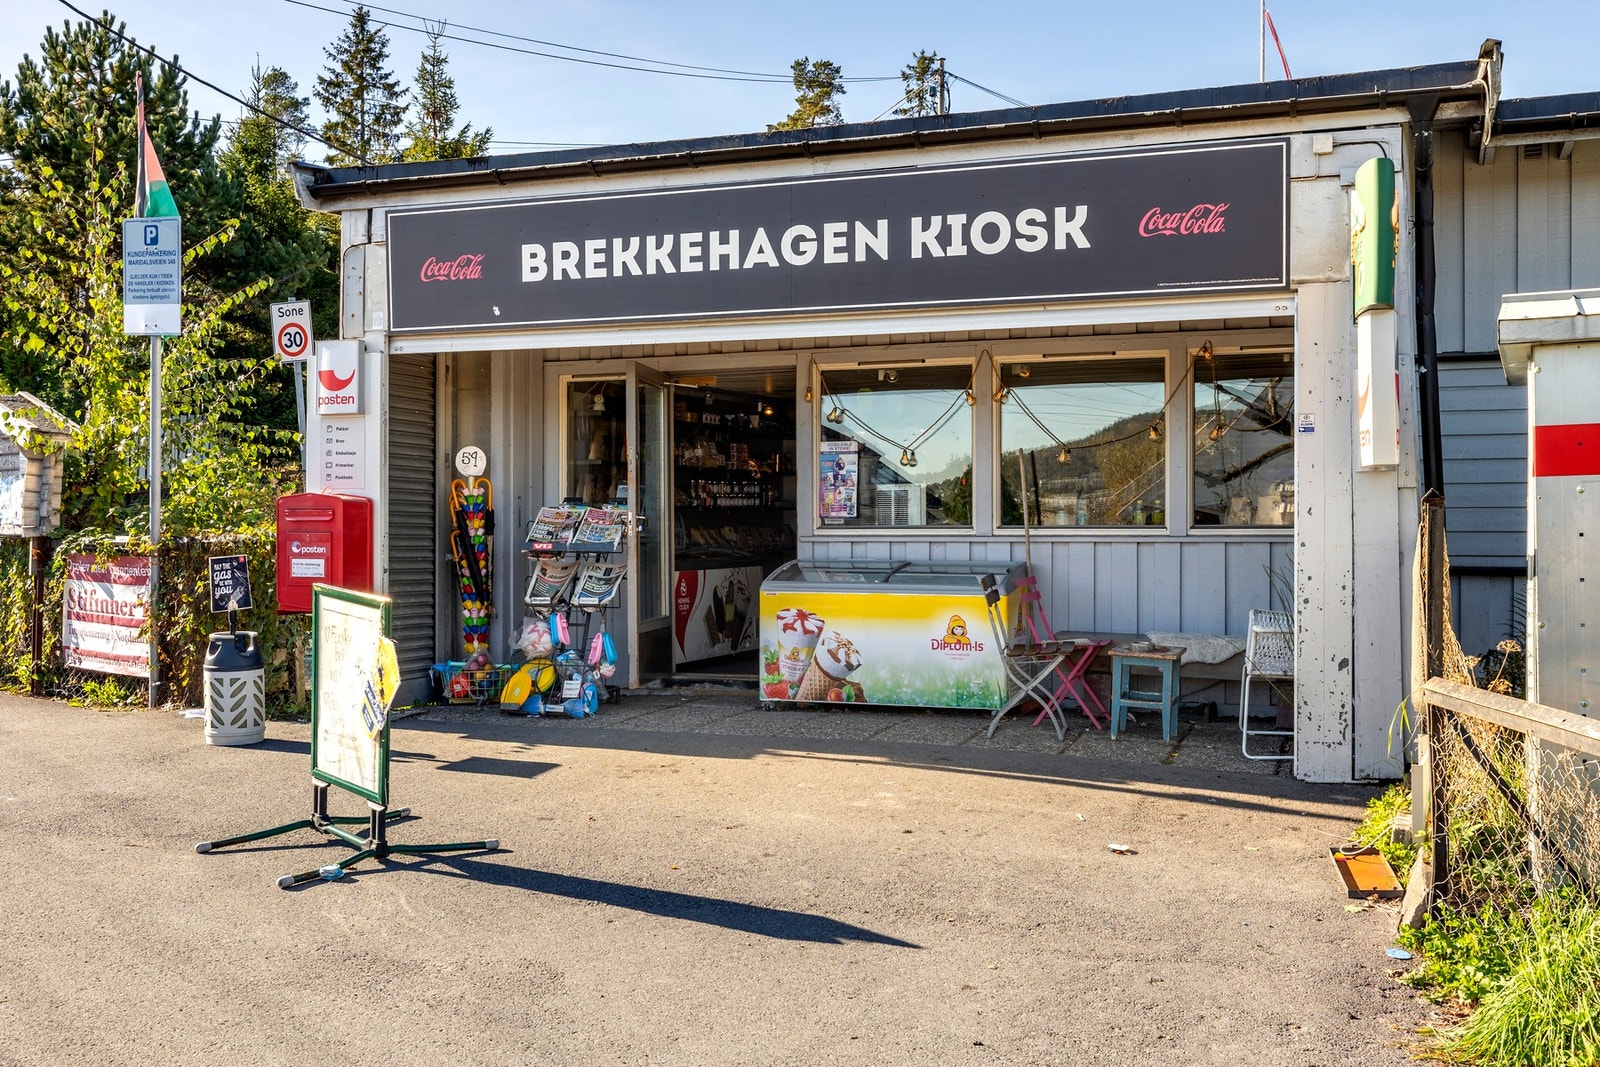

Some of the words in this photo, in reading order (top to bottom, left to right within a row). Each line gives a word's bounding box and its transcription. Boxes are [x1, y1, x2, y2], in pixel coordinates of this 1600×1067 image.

[1138, 202, 1231, 239] Coca-Cola
[146, 226, 157, 244] P
[520, 218, 889, 284] BREKKEHAGEN
[910, 204, 1092, 260] KIOSK
[127, 250, 176, 258] KUNDEPARKERING
[419, 253, 486, 283] Coca-Cola
[277, 306, 304, 318] Sone
[283, 331, 303, 349] 30
[318, 394, 355, 408] posten
[461, 450, 478, 468] 59
[301, 545, 326, 555] posten
[213, 570, 232, 585] gas
[214, 586, 234, 600] you
